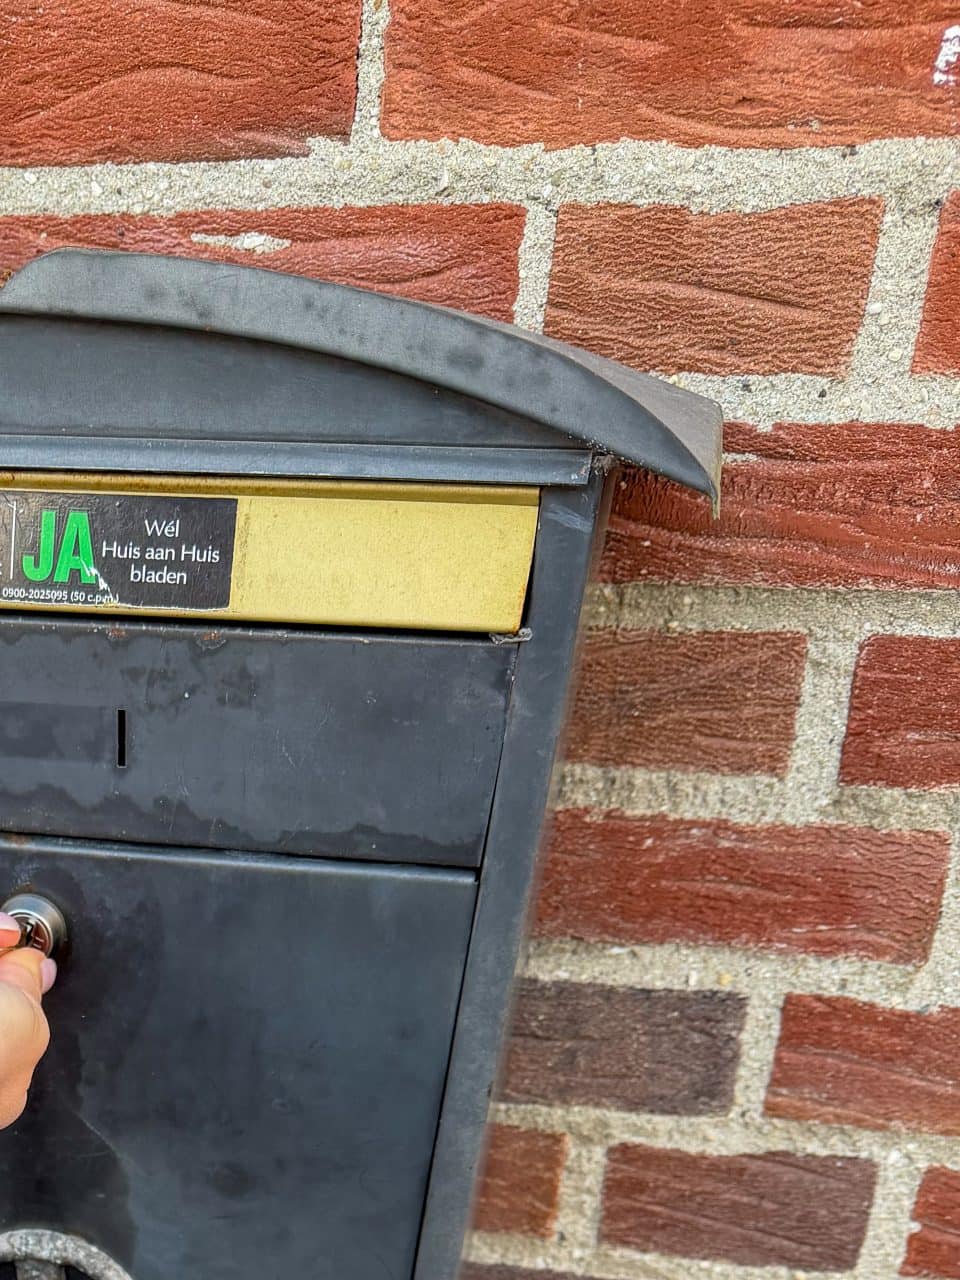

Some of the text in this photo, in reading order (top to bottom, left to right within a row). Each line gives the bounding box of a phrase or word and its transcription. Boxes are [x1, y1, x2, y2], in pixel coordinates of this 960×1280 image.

[144, 519, 180, 538] Wél
[22, 510, 96, 584] JA
[102, 541, 220, 563] Huis aan Huis
[130, 564, 187, 585] bladen
[2, 587, 68, 600] 0900-2025095
[70, 591, 85, 602] (50
